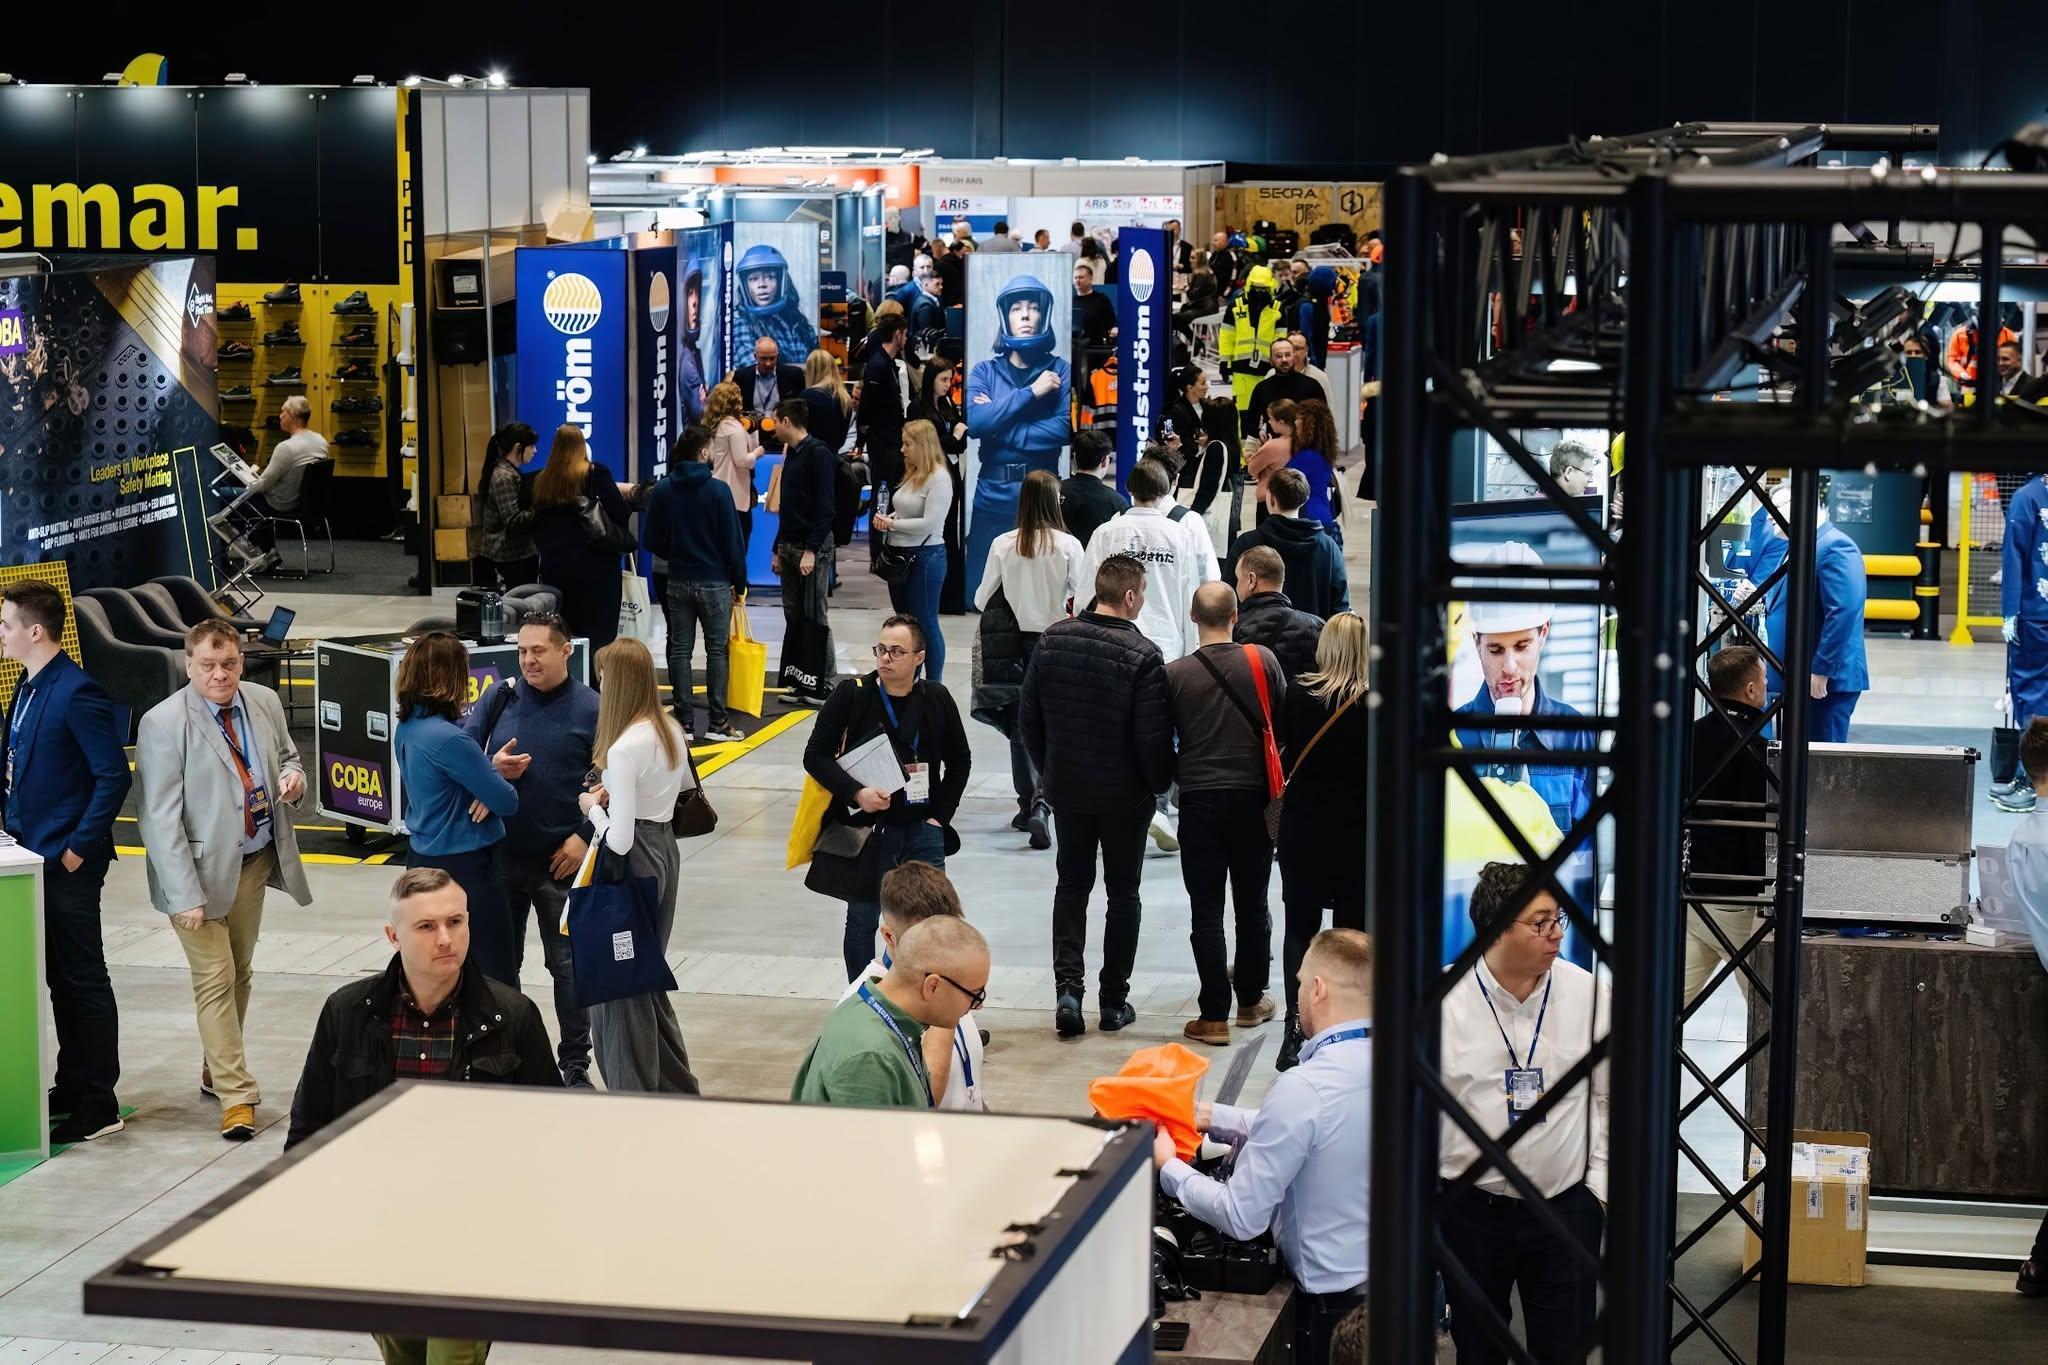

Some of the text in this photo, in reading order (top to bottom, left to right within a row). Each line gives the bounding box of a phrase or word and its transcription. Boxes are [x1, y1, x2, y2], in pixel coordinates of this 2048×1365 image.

[1260, 187, 1317, 198] SECRA
[90, 452, 170, 482] Leaders in Workplace
[120, 469, 172, 495] Safety Matting
[331, 762, 383, 798] COBA
[357, 796, 384, 811] europe
